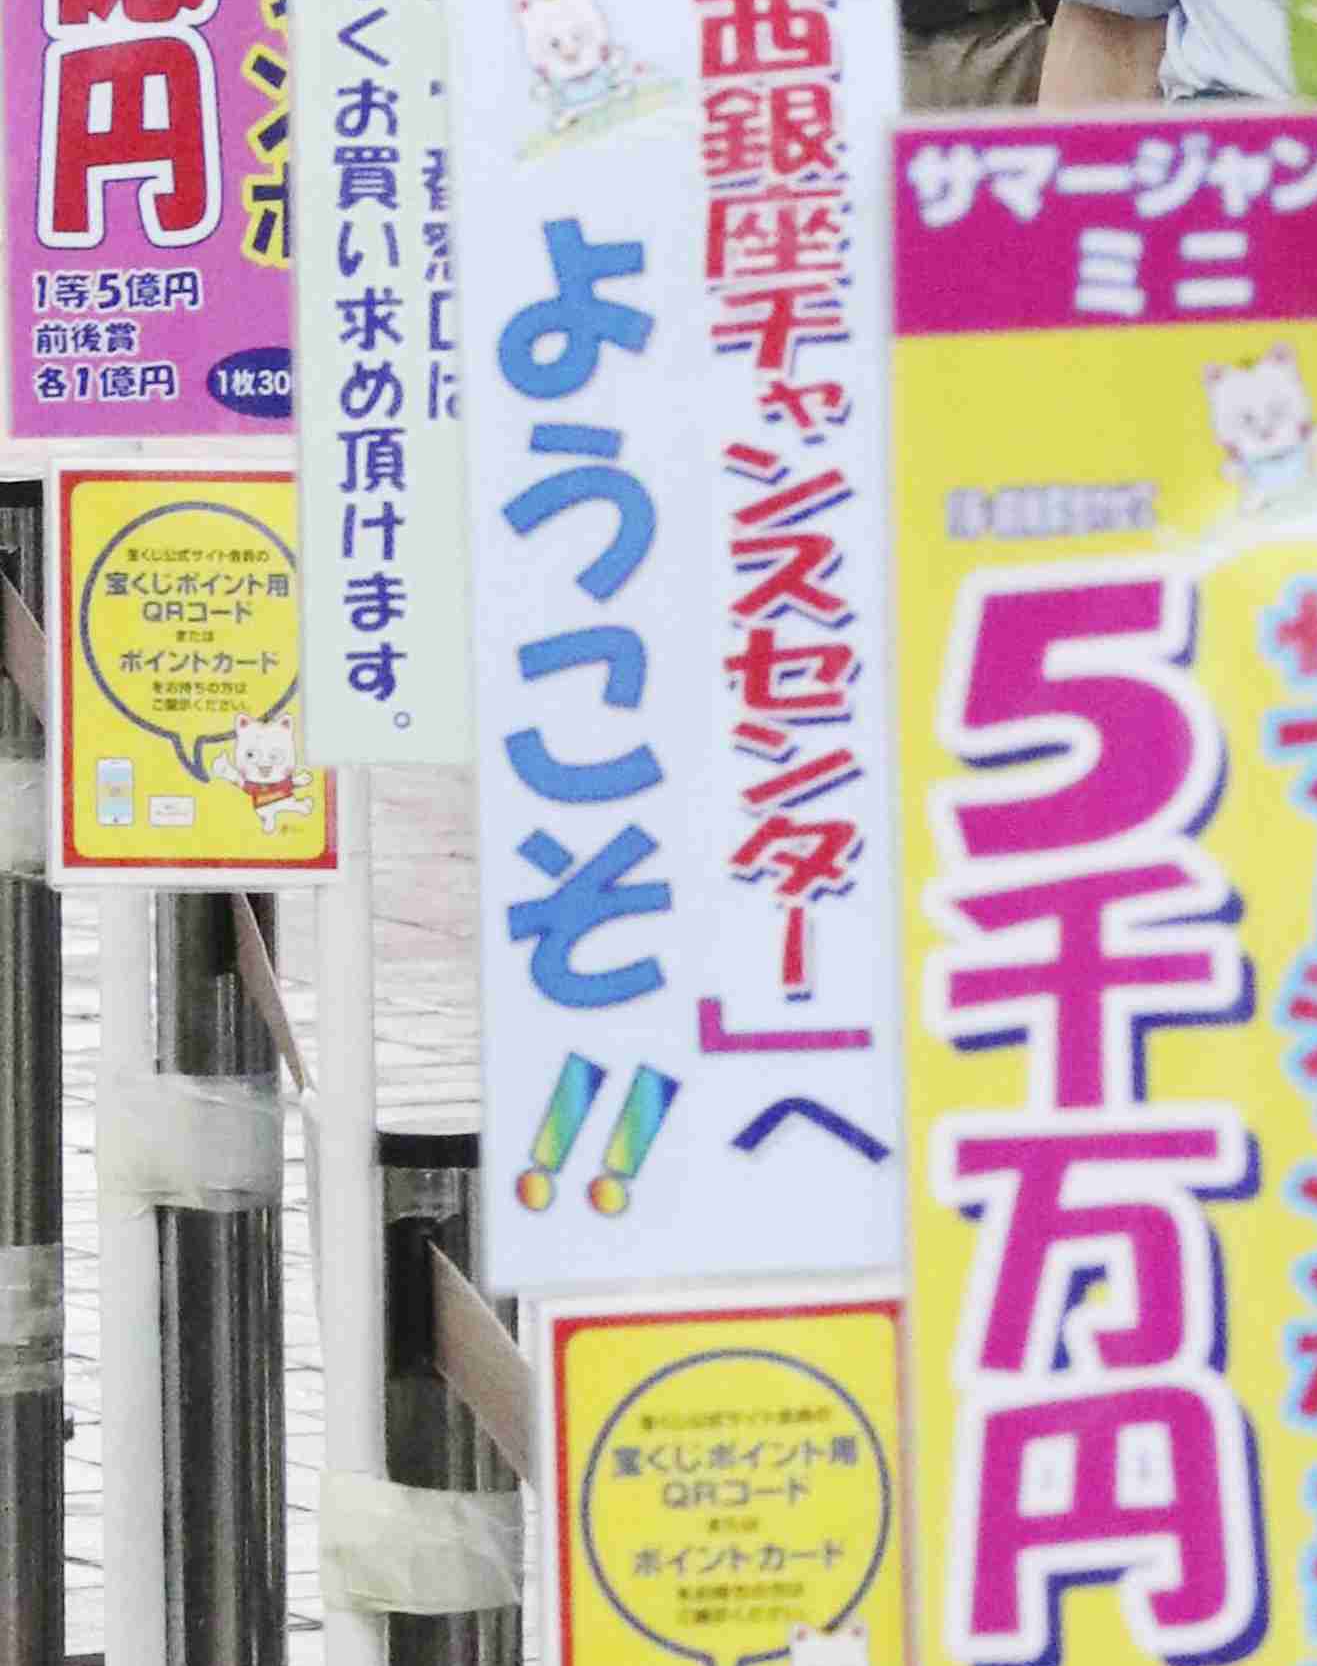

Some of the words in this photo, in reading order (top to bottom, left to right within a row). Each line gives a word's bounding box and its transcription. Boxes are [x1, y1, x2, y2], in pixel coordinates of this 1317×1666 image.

[35, 269, 202, 310] 1等5億円
[1074, 229, 1255, 317] ミニ
[35, 321, 138, 355] 前後賞
[36, 362, 177, 399] 各1億円
[105, 572, 290, 597] 宝くじポイント用
[142, 601, 252, 624] QRコード
[119, 650, 280, 675] ポイントカード
[633, 1539, 846, 1578] ポイントカード
